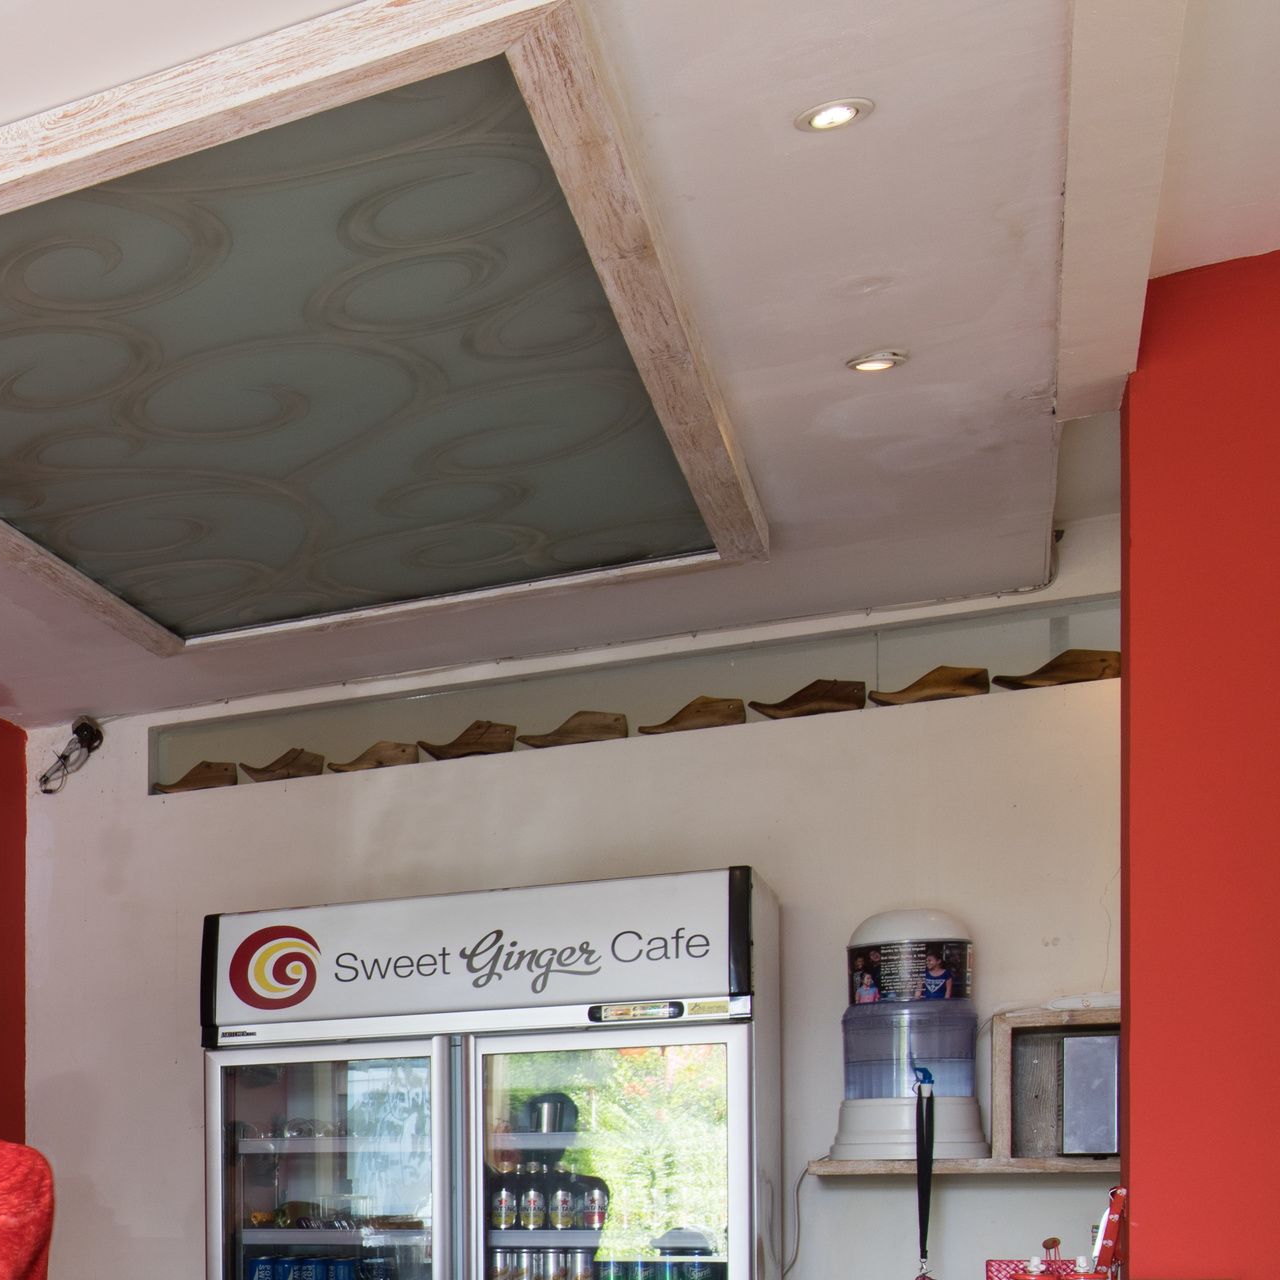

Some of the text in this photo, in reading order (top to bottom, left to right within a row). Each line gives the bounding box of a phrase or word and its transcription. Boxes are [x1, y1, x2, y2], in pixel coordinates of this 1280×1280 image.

[334, 927, 711, 994] Sweet Ginger Cafe
